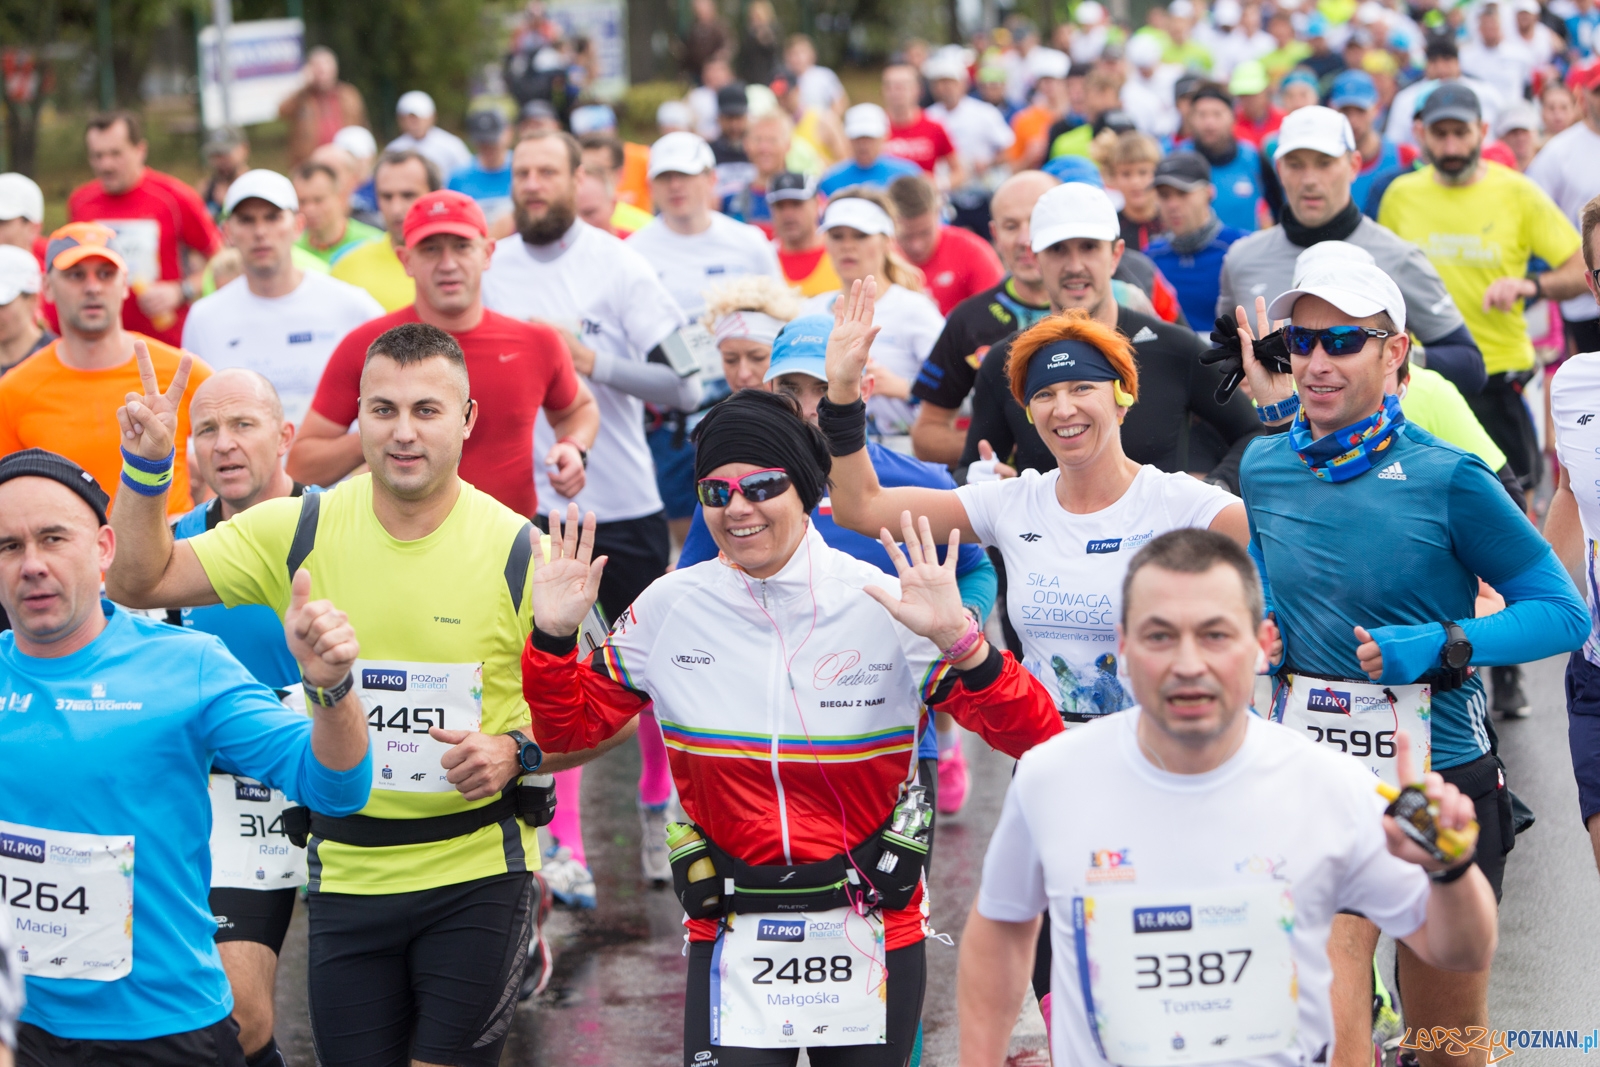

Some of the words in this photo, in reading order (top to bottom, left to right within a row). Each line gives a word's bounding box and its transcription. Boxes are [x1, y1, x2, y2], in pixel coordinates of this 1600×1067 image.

[1577, 414, 1595, 425] 4F
[1378, 472, 1407, 481] adidas
[1019, 533, 1042, 542] 4F
[1026, 573, 1060, 588] SIŁA
[1033, 590, 1112, 608] ODWAGA
[440, 617, 461, 625] BRUGI
[1021, 606, 1114, 625] SZYBKOŚĆ
[1026, 629, 1033, 637] 9
[1034, 631, 1089, 641] października
[1092, 633, 1115, 642] 2016
[676, 655, 711, 665] VEZUVIO
[813, 650, 880, 690] Poetów
[868, 663, 893, 672] OSIEDLE
[381, 675, 404, 686] PKO
[410, 682, 448, 690] maraton
[95, 701, 143, 710] LECHITÓW
[820, 700, 854, 708] BIEGAJ
[864, 698, 886, 707] NAMI
[368, 705, 445, 734] 4451
[387, 740, 420, 753] Piotr
[410, 773, 427, 781] 4F
[240, 814, 286, 837] 314
[17, 841, 42, 857] PKO
[259, 845, 289, 855] Rafał
[50, 853, 92, 865] maraton
[0, 874, 89, 915] 1264
[16, 917, 67, 938] Maciej
[778, 926, 801, 936] PKO
[50, 957, 68, 966] 4F
[752, 955, 852, 985] 2488
[1135, 949, 1252, 989] 3387
[767, 992, 839, 1007] Małgośka
[1161, 998, 1233, 1014] Tomasz
[813, 1025, 829, 1034] 4F
